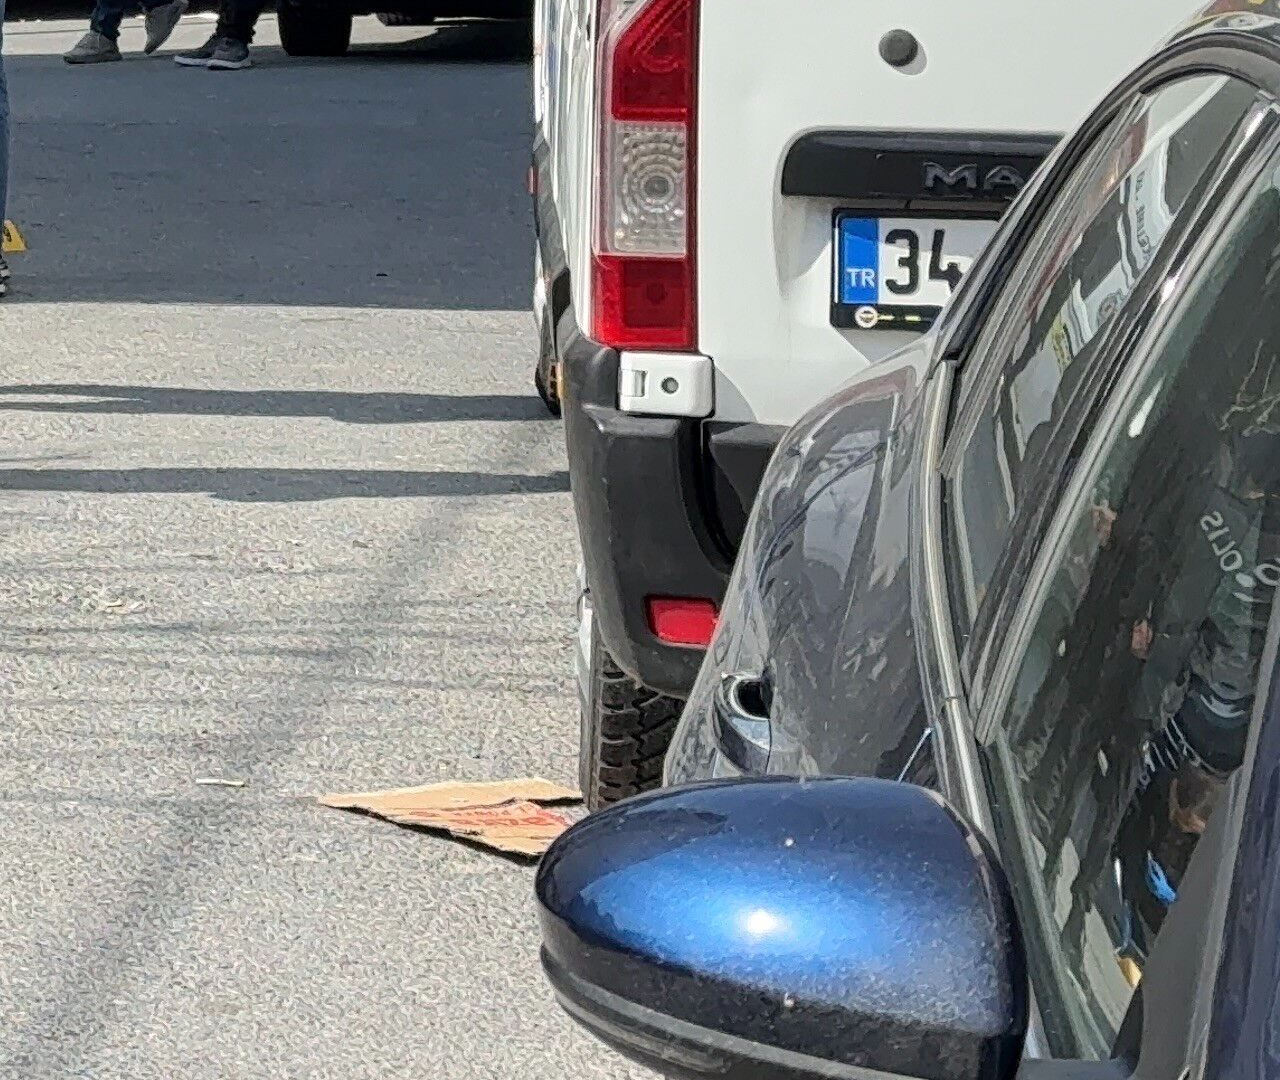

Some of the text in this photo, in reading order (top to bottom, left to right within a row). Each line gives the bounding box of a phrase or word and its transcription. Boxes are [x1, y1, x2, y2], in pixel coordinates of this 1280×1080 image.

[922, 161, 1028, 192] MA
[846, 228, 964, 297] TR 34
